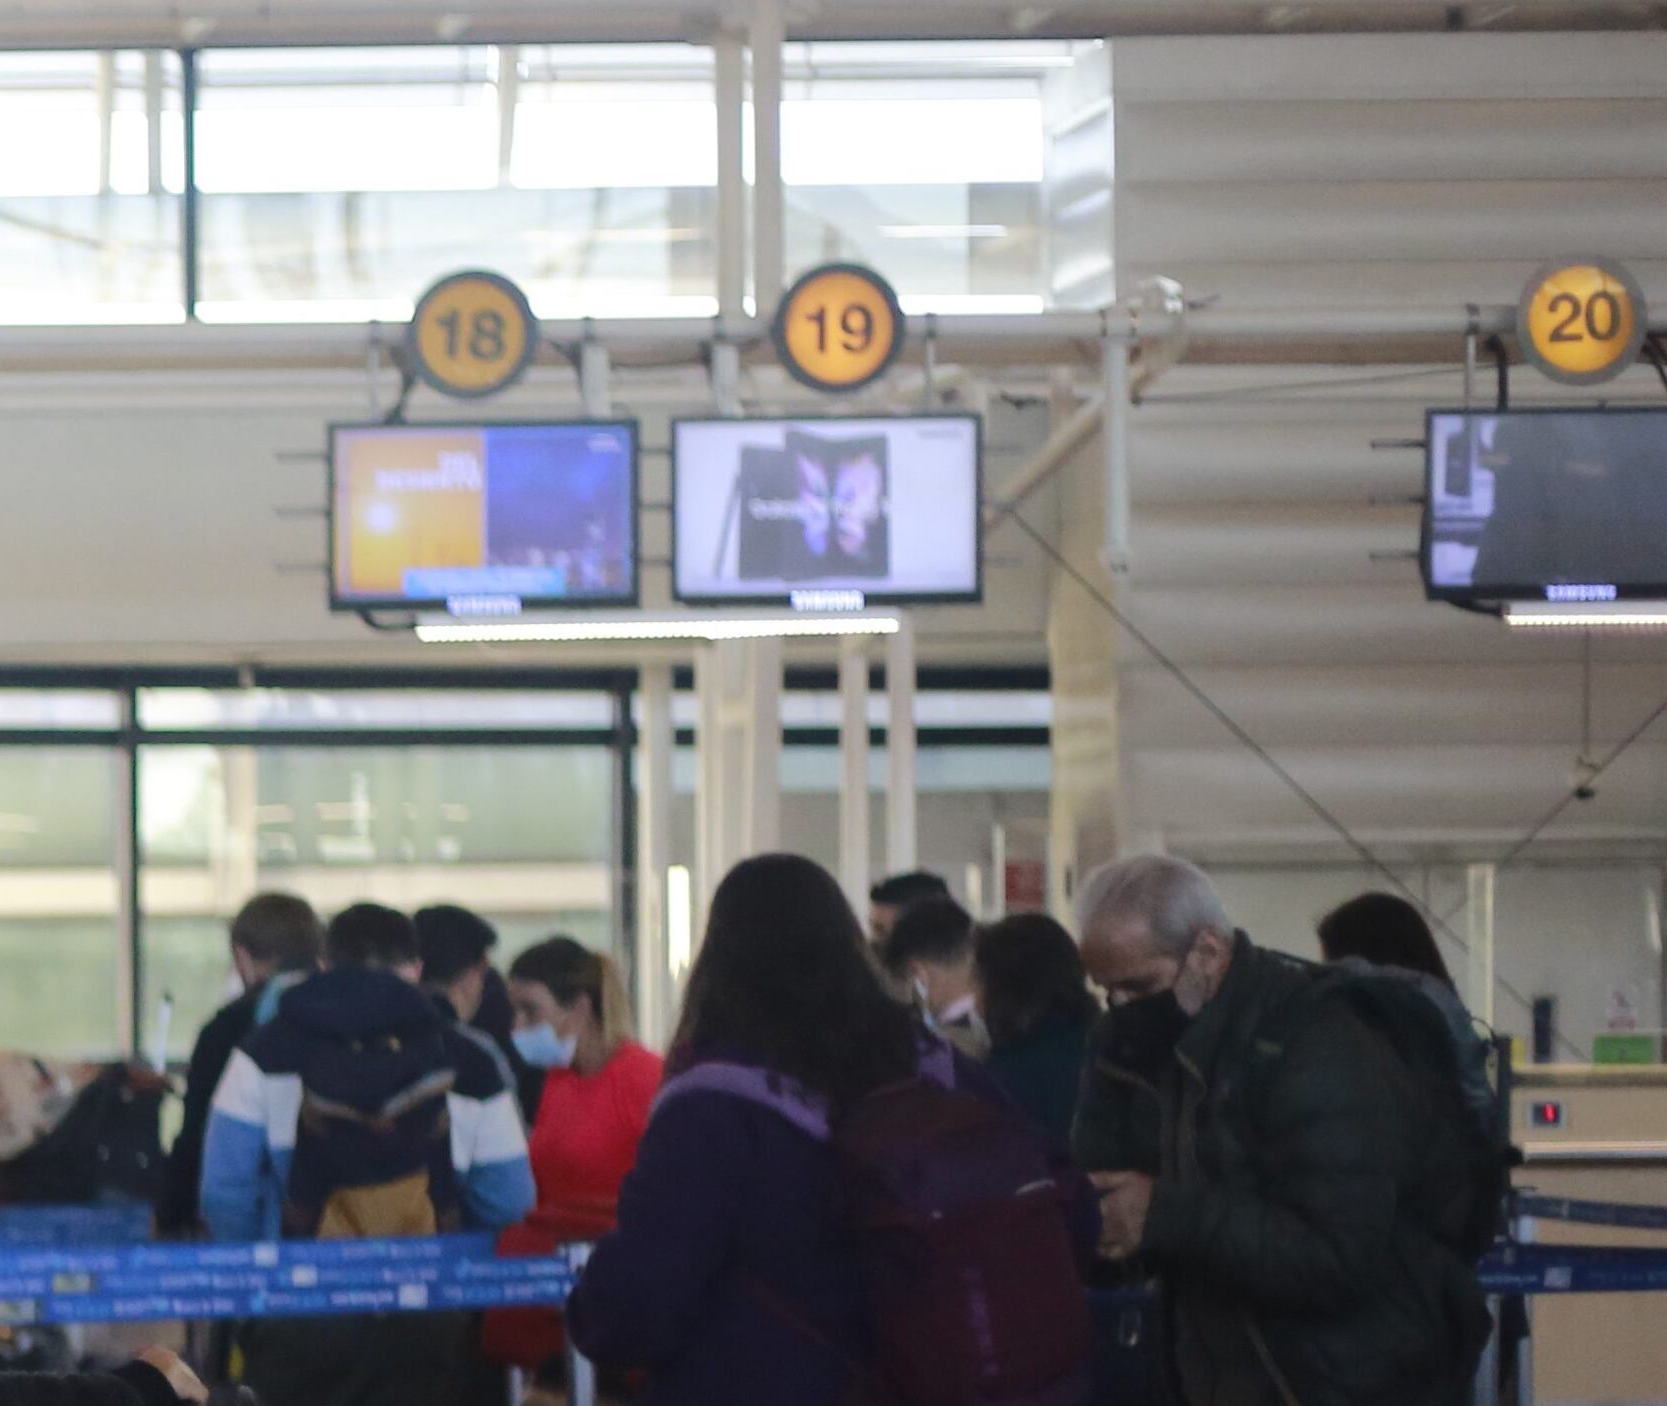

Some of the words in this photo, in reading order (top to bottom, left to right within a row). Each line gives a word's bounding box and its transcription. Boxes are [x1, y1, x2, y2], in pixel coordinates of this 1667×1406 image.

[436, 309, 507, 361] 18
[805, 304, 875, 353] 19
[1548, 291, 1623, 343] 20
